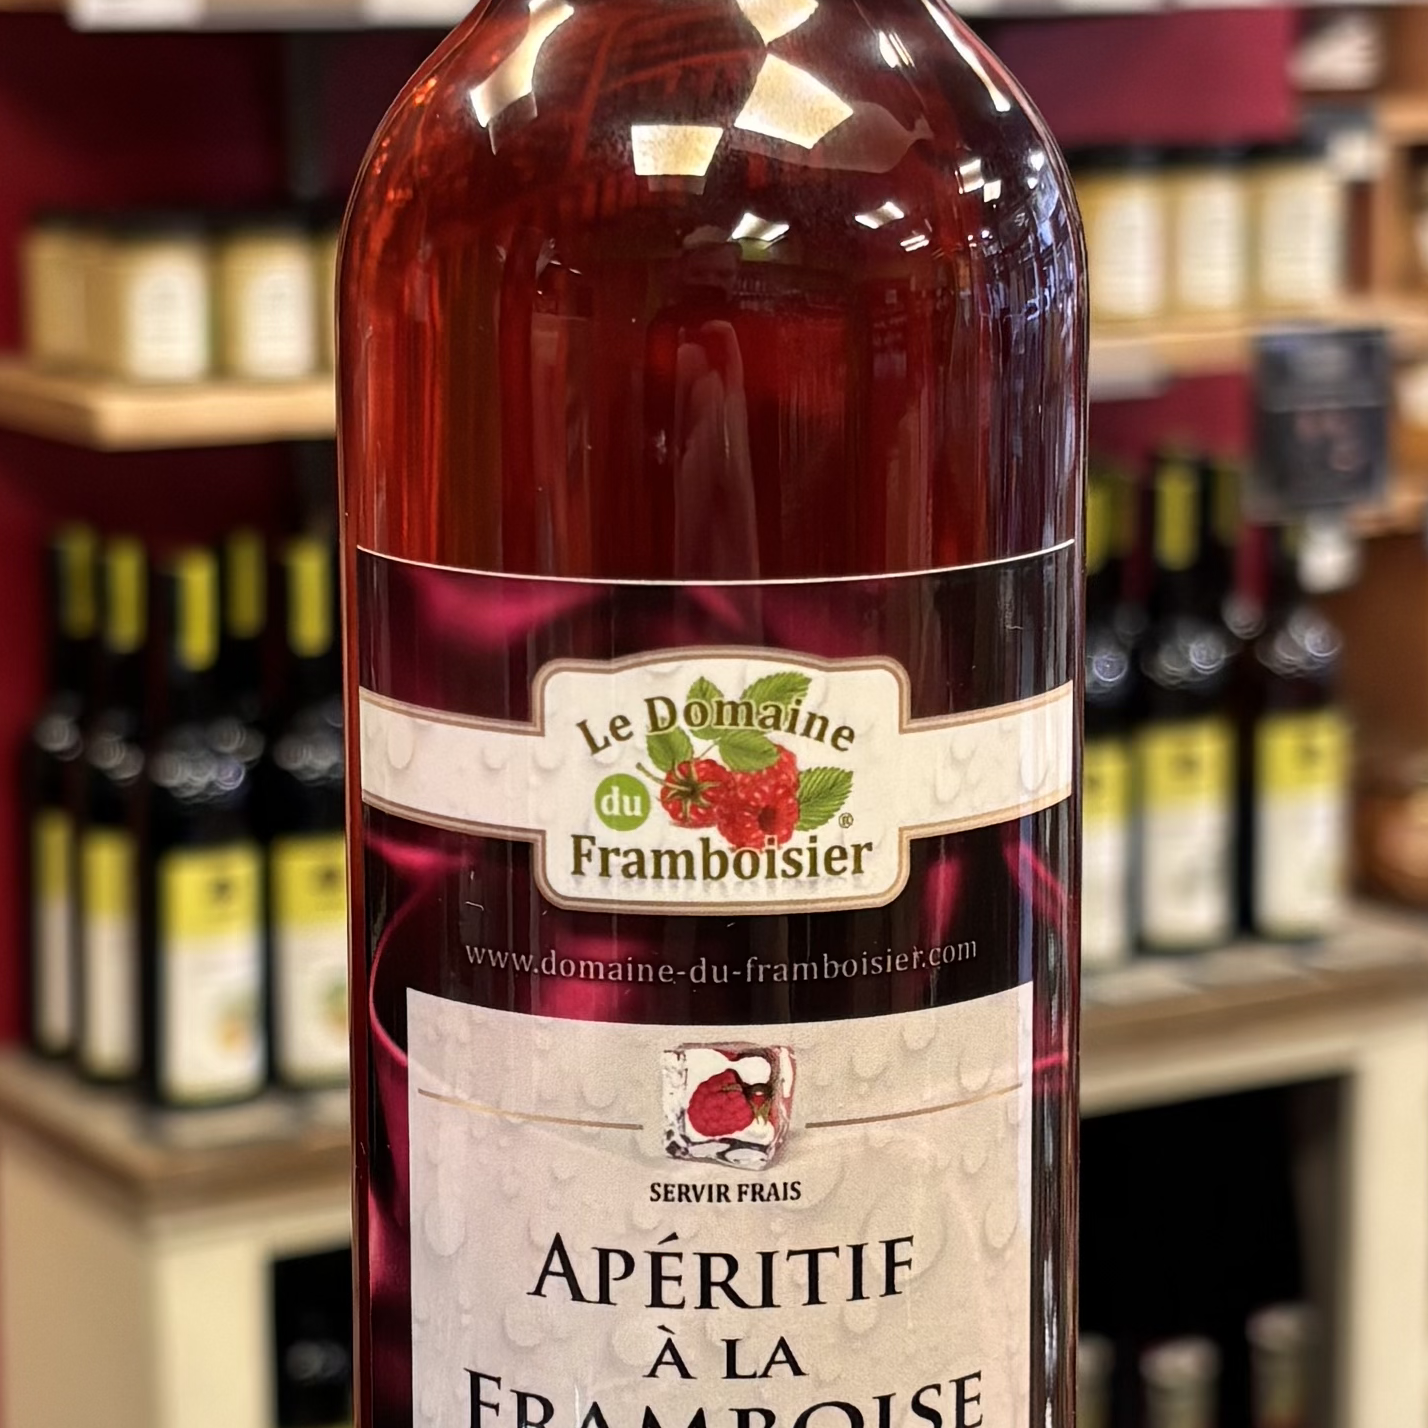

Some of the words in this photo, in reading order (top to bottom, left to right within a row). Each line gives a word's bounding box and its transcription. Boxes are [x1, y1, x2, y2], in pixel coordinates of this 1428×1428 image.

[575, 708, 633, 756] Le
[644, 695, 857, 753] Domaine
[599, 787, 643, 819] du
[570, 833, 874, 882] Framboisier
[465, 937, 978, 986] www.domaine-du-framboisier.com
[649, 1182, 732, 1204] SERVIR
[737, 1180, 802, 1203] FRAIS
[526, 1231, 915, 1310] APÉRITIF
[642, 1324, 697, 1380] À
[720, 1335, 808, 1380] LA
